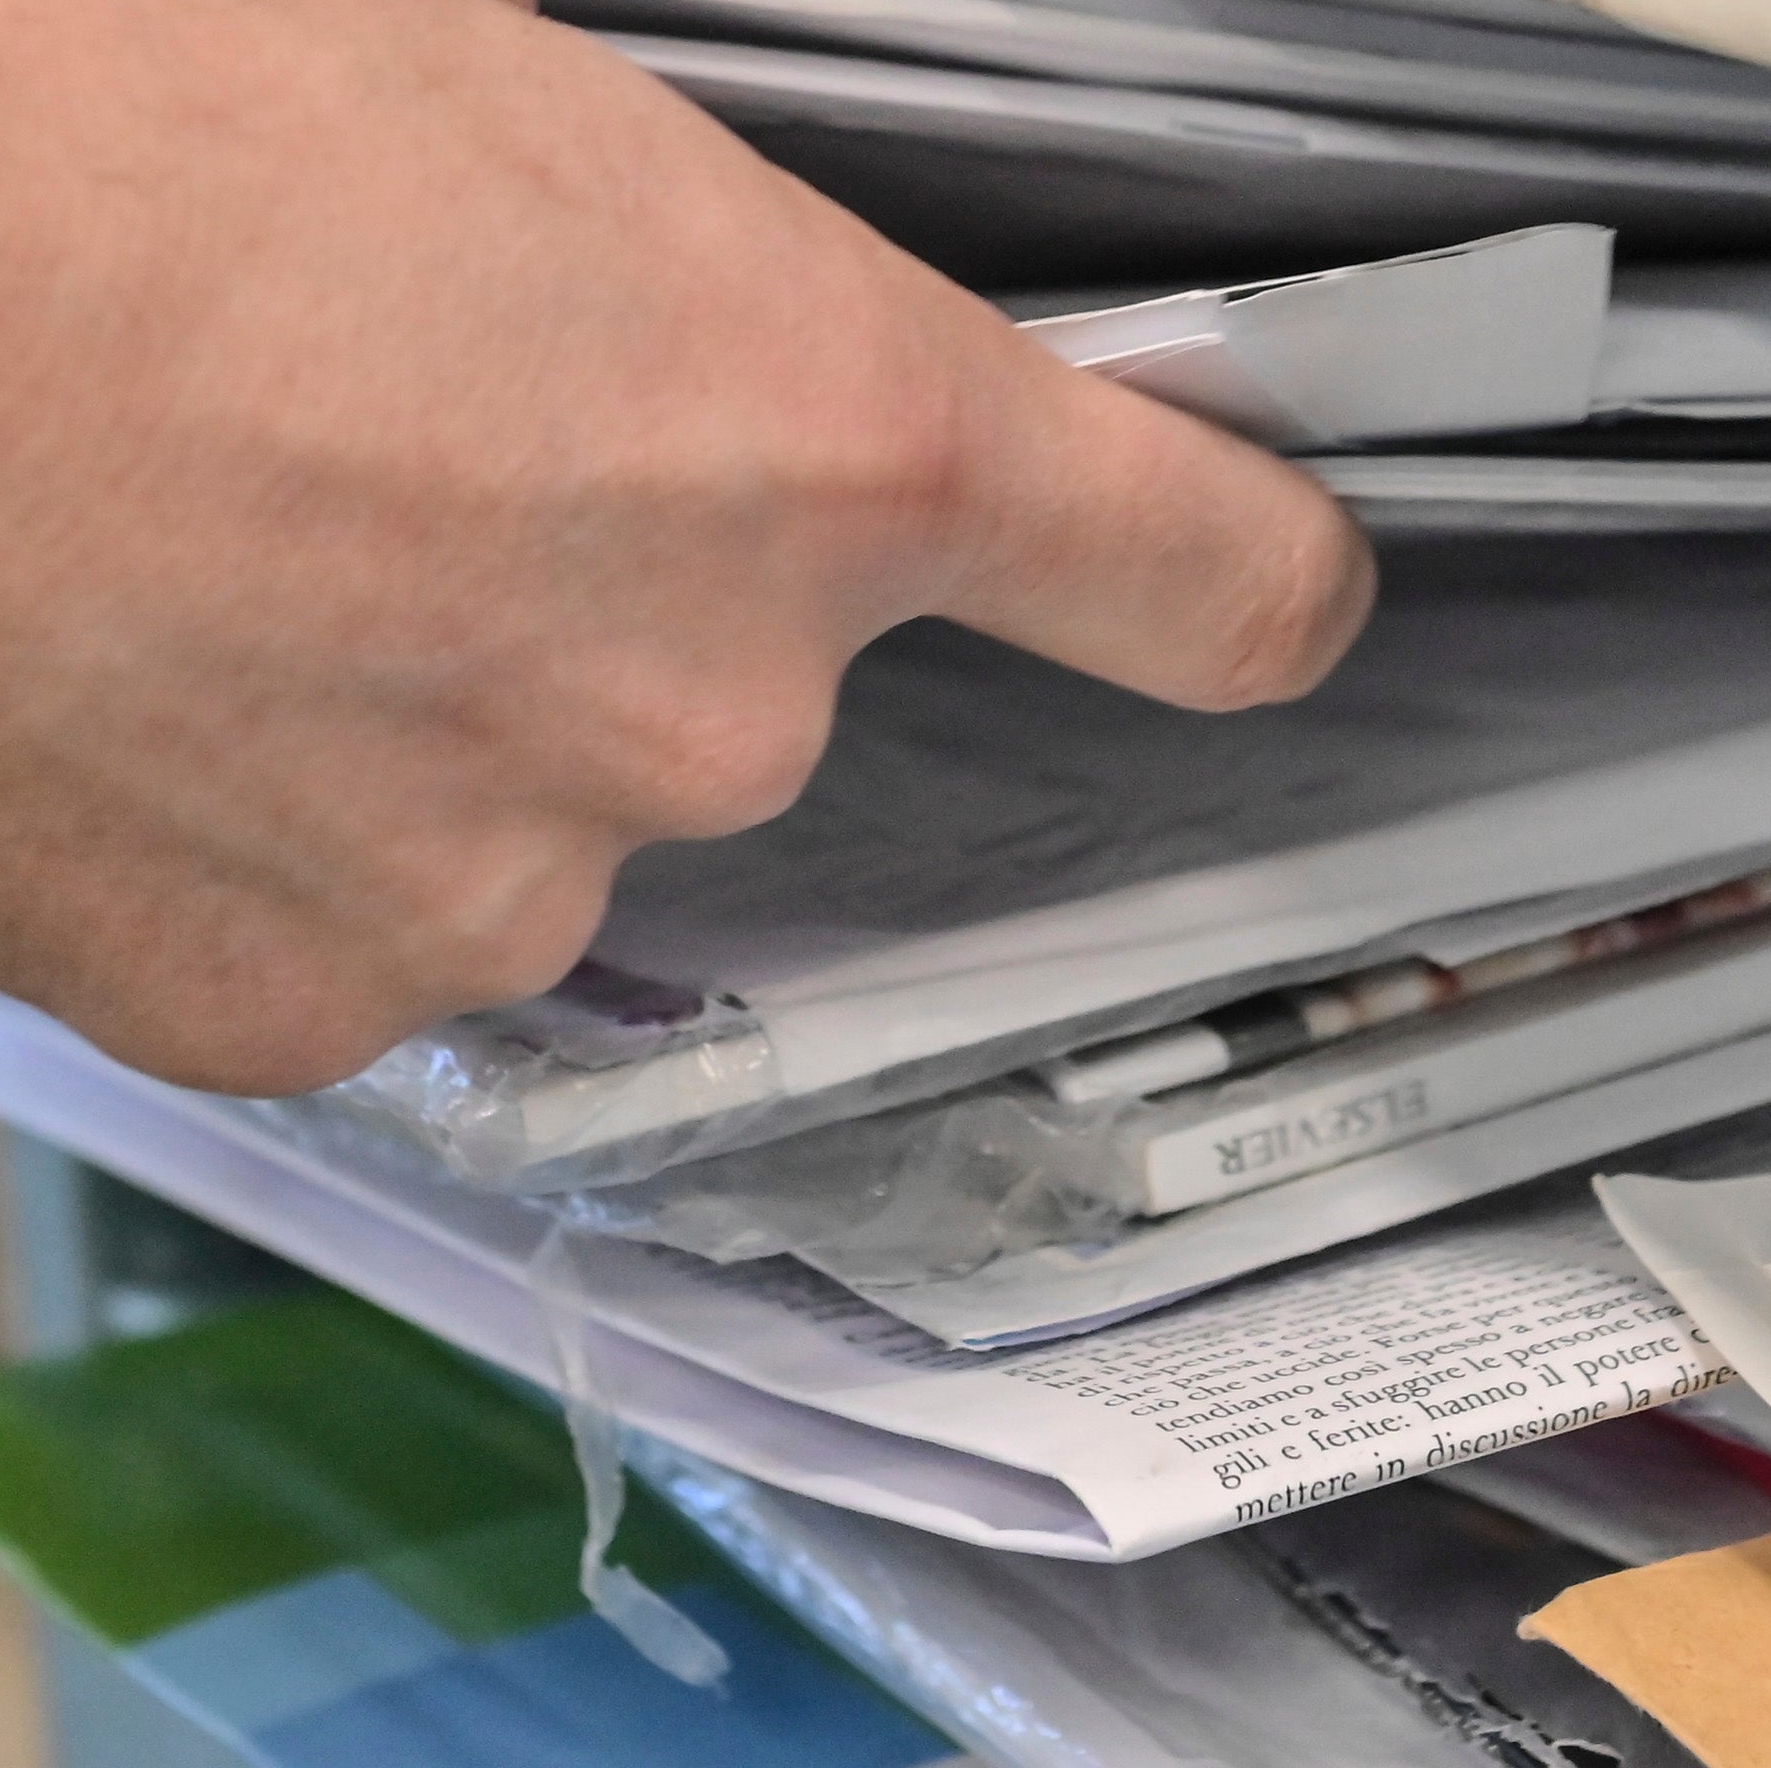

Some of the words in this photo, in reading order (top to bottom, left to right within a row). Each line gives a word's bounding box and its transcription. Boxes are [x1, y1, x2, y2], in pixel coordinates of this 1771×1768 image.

[1212, 1078, 1429, 1175] ELSEVIER
[1043, 1375, 1095, 1390] ha
[1077, 1385, 1113, 1398] di
[1118, 1347, 1245, 1385] rispetto
[1103, 1386, 1163, 1407] che
[1167, 1359, 1272, 1390] passa,
[1302, 1334, 1353, 1350] ciò
[1130, 1398, 1180, 1417] ciò
[1187, 1381, 1247, 1401] che
[1249, 1350, 1371, 1383] uccide.
[1368, 1322, 1467, 1349] Forse
[1469, 1305, 1524, 1328] per
[1155, 1384, 1315, 1432] tendiamo
[1323, 1360, 1391, 1387] così
[1395, 1332, 1502, 1367] spesso
[1508, 1324, 1533, 1335] a
[1537, 1292, 1651, 1326] negare
[1176, 1416, 1277, 1453] limiti
[1280, 1414, 1302, 1427] e
[1304, 1407, 1330, 1420] a
[1330, 1367, 1466, 1413] sfuggire
[1460, 1356, 1503, 1373] le
[1502, 1319, 1636, 1369] persone
[1212, 1448, 1271, 1490] gili
[1280, 1445, 1303, 1460] e
[1307, 1415, 1411, 1452] ferite:
[1412, 1381, 1528, 1421] hanno
[1532, 1363, 1567, 1388] il
[1572, 1336, 1681, 1388] potere
[1235, 1471, 1357, 1520] mettere
[1373, 1451, 1405, 1483] in
[1426, 1401, 1608, 1468] discussione
[1620, 1380, 1651, 1412] la
